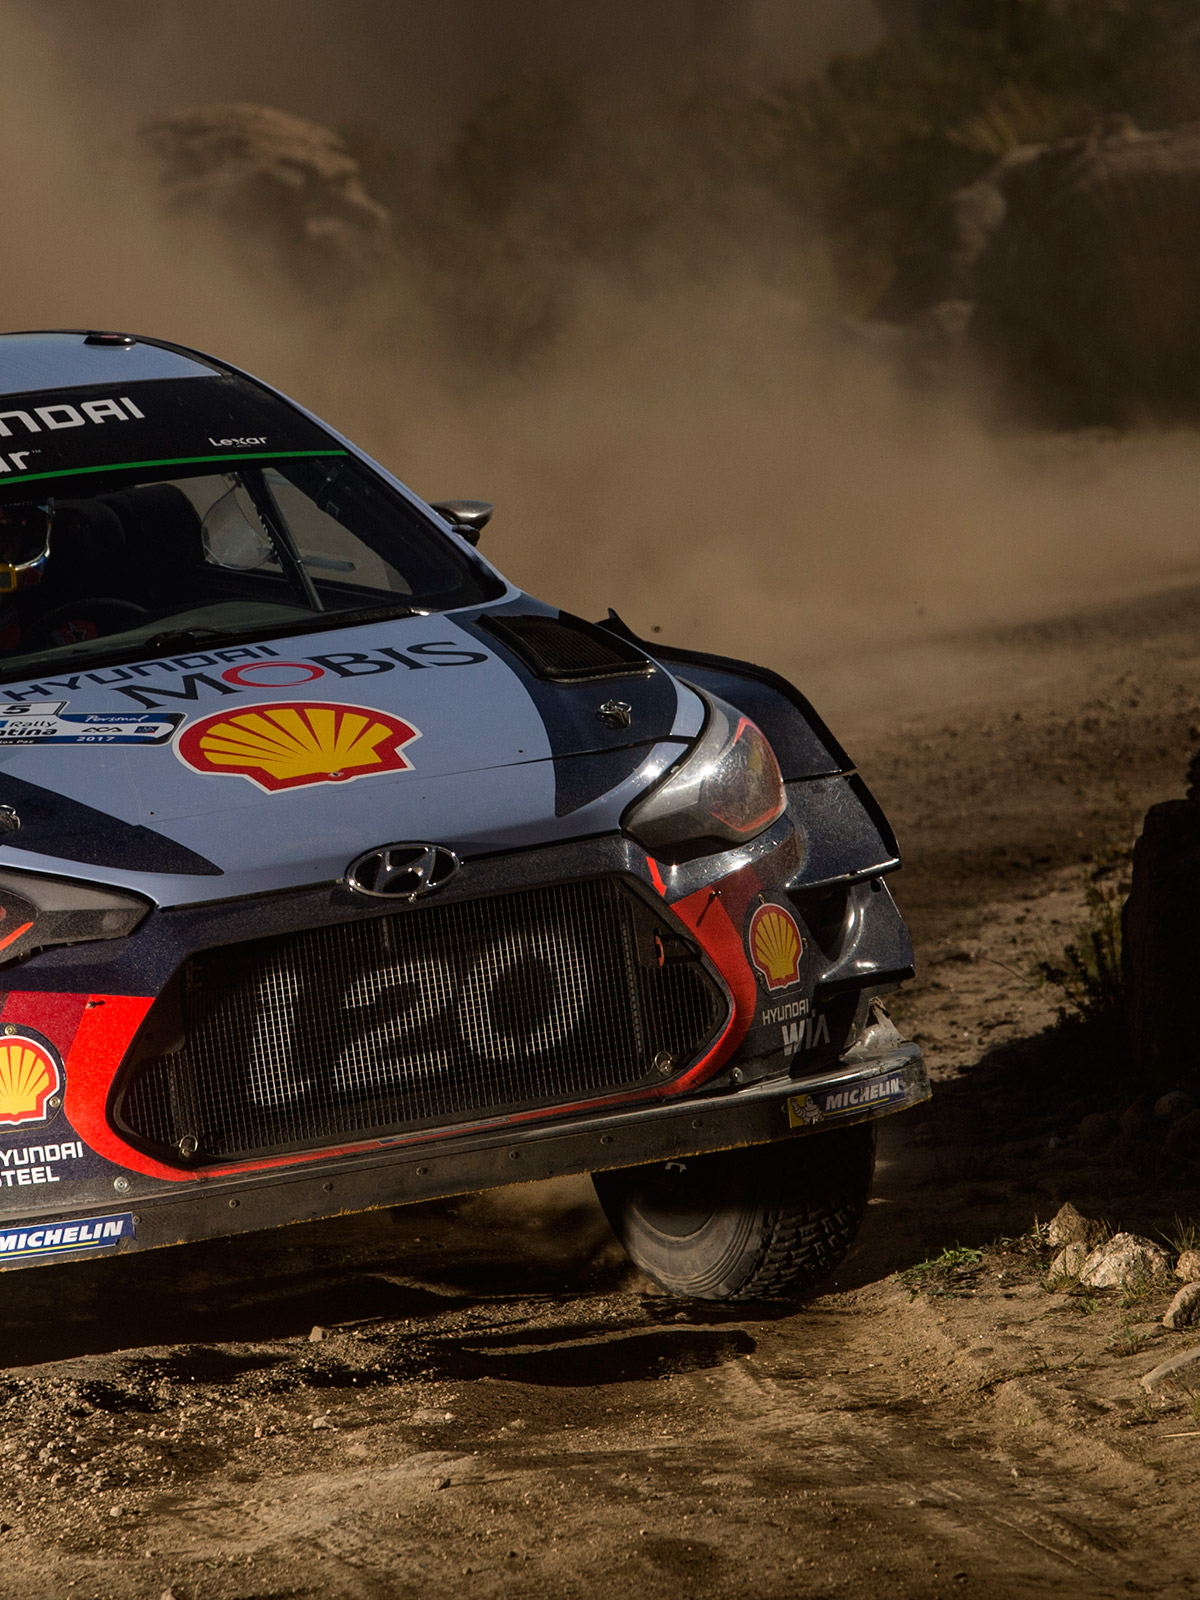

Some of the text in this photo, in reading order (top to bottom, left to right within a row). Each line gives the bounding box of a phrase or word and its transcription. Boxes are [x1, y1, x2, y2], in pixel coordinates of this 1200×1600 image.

[208, 436, 267, 447] Lexar
[3, 645, 280, 702] HYUNDAI
[109, 641, 489, 711] MOBIS
[2, 704, 32, 714] 5
[9, 720, 57, 728] Rally
[85, 715, 149, 723] Personal
[762, 998, 809, 1026] HYUNDAI
[825, 1077, 900, 1111] MICHELIN
